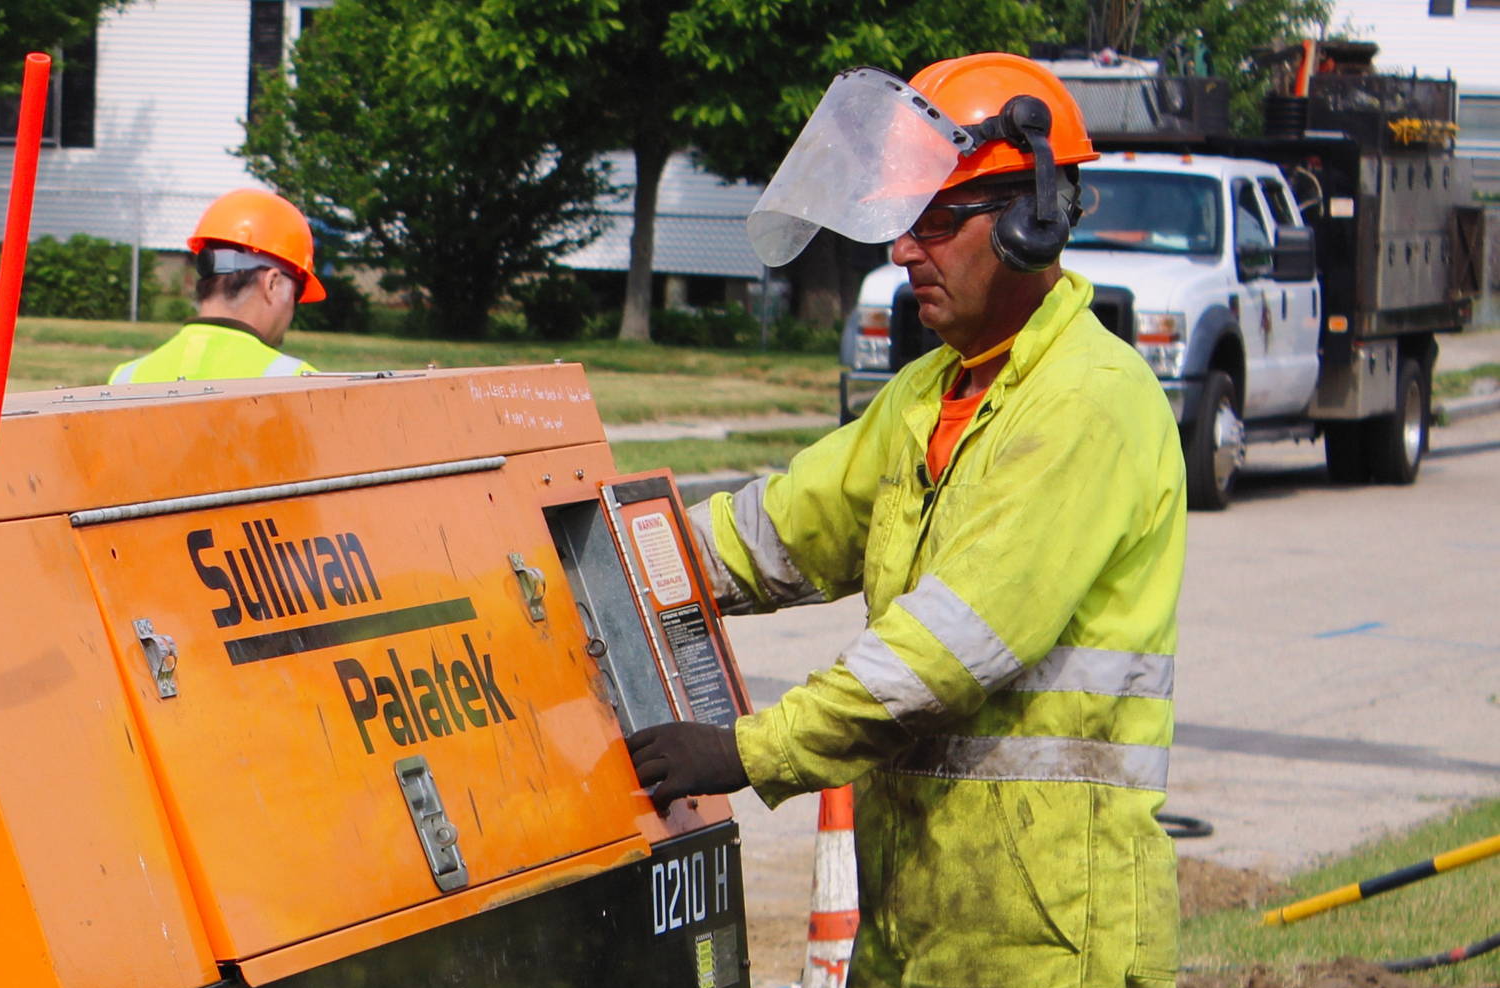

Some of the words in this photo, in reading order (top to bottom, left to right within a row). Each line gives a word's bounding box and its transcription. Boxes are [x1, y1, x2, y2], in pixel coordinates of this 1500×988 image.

[186, 518, 382, 629] Sullivan
[333, 633, 517, 755] Palatek
[714, 844, 729, 914] H
